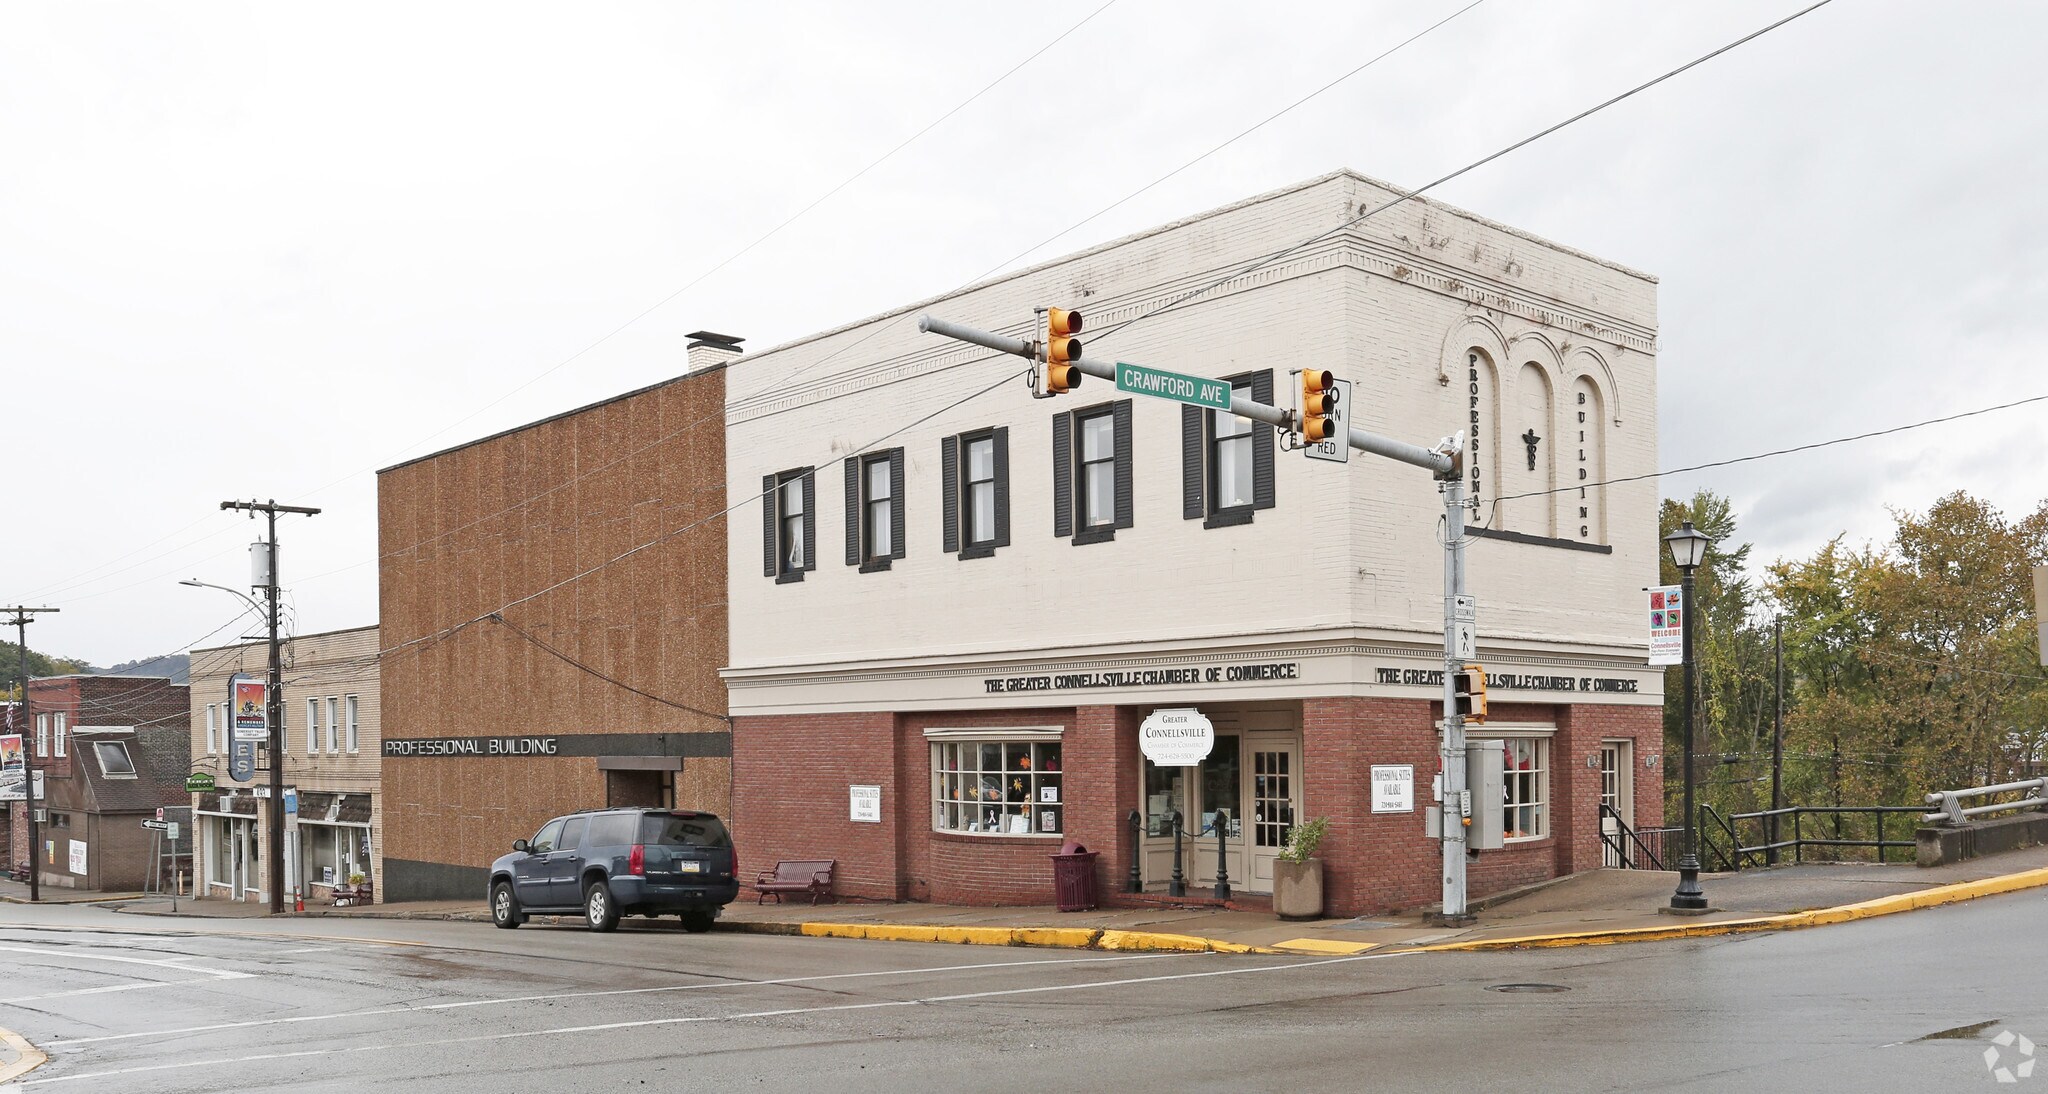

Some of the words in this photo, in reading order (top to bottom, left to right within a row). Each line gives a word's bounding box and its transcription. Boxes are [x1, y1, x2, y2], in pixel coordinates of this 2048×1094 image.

[1124, 369, 1194, 398] CRAWFORD
[1200, 384, 1223, 403] AVE
[1469, 354, 1481, 521] PROFESSIONAL
[1317, 442, 1336, 455] RED
[1577, 392, 1589, 537] BUILDING
[1651, 629, 1681, 637] WELCOME
[984, 679, 1004, 693] THE
[1006, 677, 1050, 692] GREATER
[1054, 671, 1142, 689] CONNELLSVILLE
[1142, 669, 1200, 685] CHAMBER
[1205, 667, 1222, 682] OF
[1226, 663, 1297, 681] COMMERCE
[1377, 668, 1401, 683] THE
[1403, 670, 1444, 686] GREATE
[1485, 673, 1532, 689] ELLSVILLE
[1532, 676, 1575, 691] CHAMBER
[1579, 677, 1592, 691] OF
[1593, 678, 1638, 693] COMMERCE
[1162, 715, 1188, 723] GREATER
[1145, 727, 1206, 738] CONNELLSVILLE
[386, 740, 483, 755] PROFESSIONAL
[489, 738, 556, 754] BUILDING
[1374, 769, 1398, 781] PROFESSIONAL
